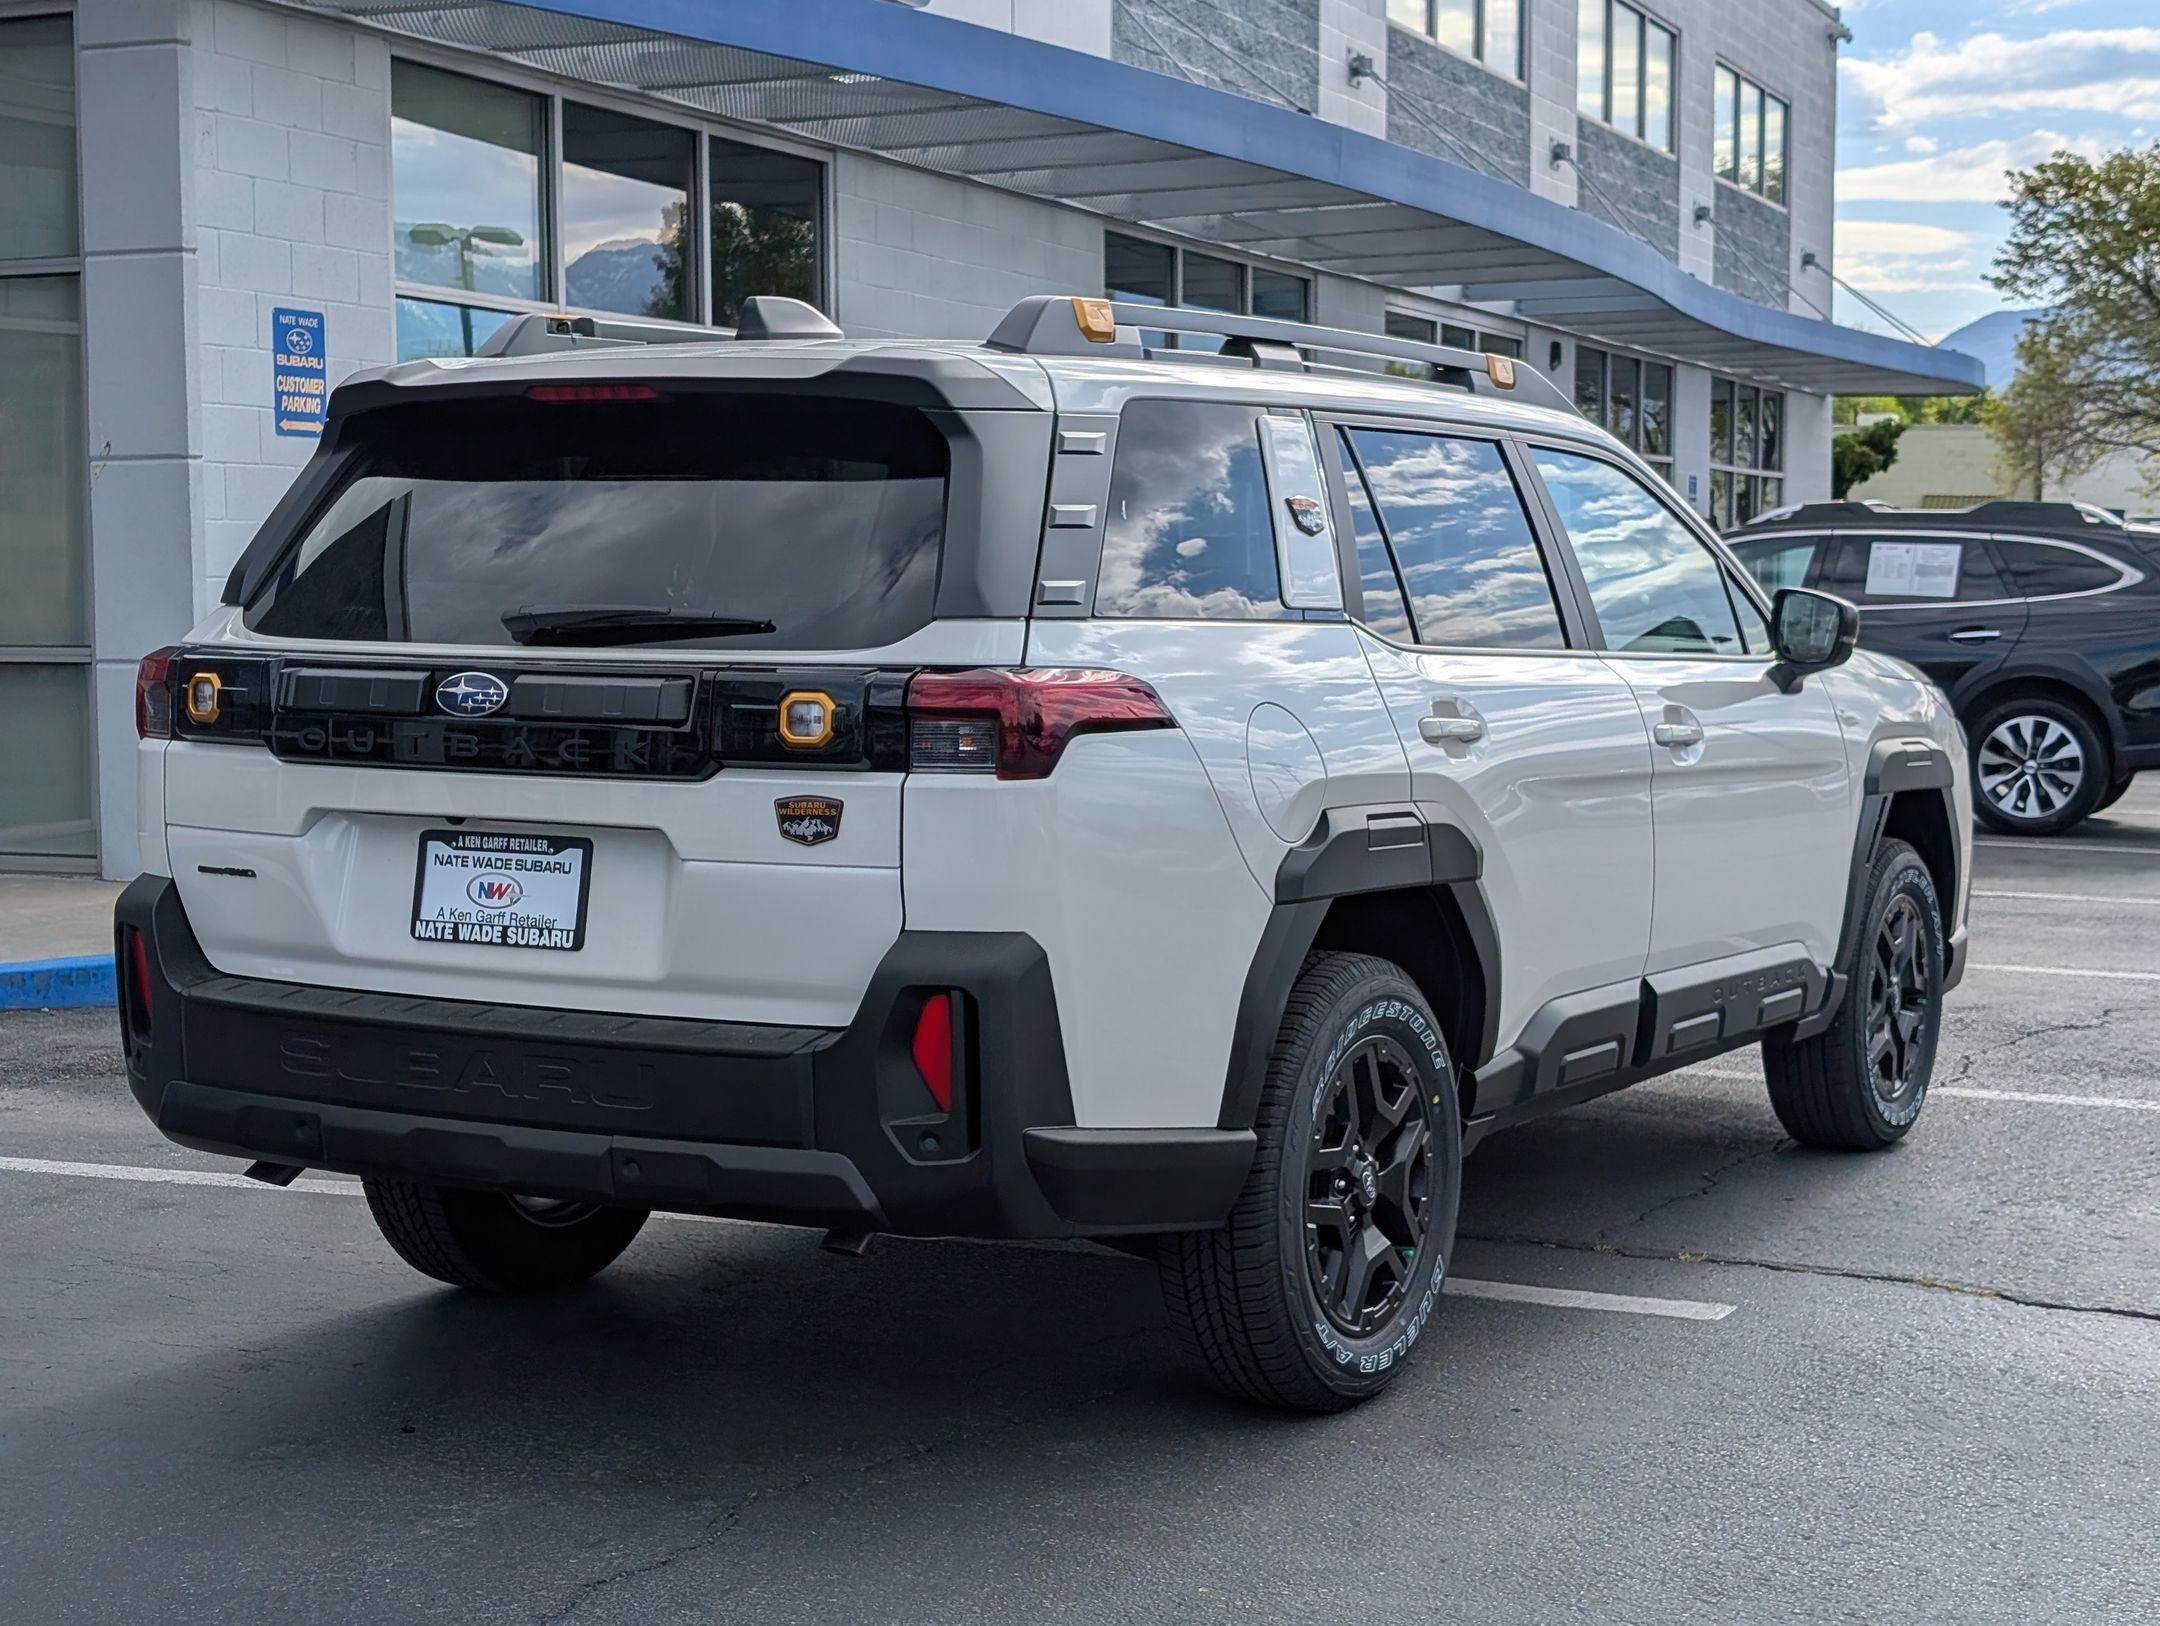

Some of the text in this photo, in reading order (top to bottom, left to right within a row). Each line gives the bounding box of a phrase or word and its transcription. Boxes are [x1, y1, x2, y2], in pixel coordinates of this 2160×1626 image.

[279, 314, 319, 328] NATE WADE
[276, 354, 323, 369] SUBARU
[276, 375, 324, 395] CUSTOMER
[281, 395, 321, 414] PARKING
[296, 725, 650, 765] OUTBACK
[778, 808, 837, 816] WILDERNESS
[788, 801, 826, 809] SUBARU
[458, 835, 548, 852] A KEN GARFF RETAILER
[434, 854, 572, 875] NATE WADE SUBARU
[477, 881, 513, 900] NW
[436, 907, 558, 929] A Ken Garff Retailer
[415, 920, 574, 949] NATE WADE SUBARU
[1311, 1001, 1447, 1121] BRIDGESTONE
[279, 1034, 656, 1110] SUBARU
[1359, 1253, 1445, 1373] DUELER
